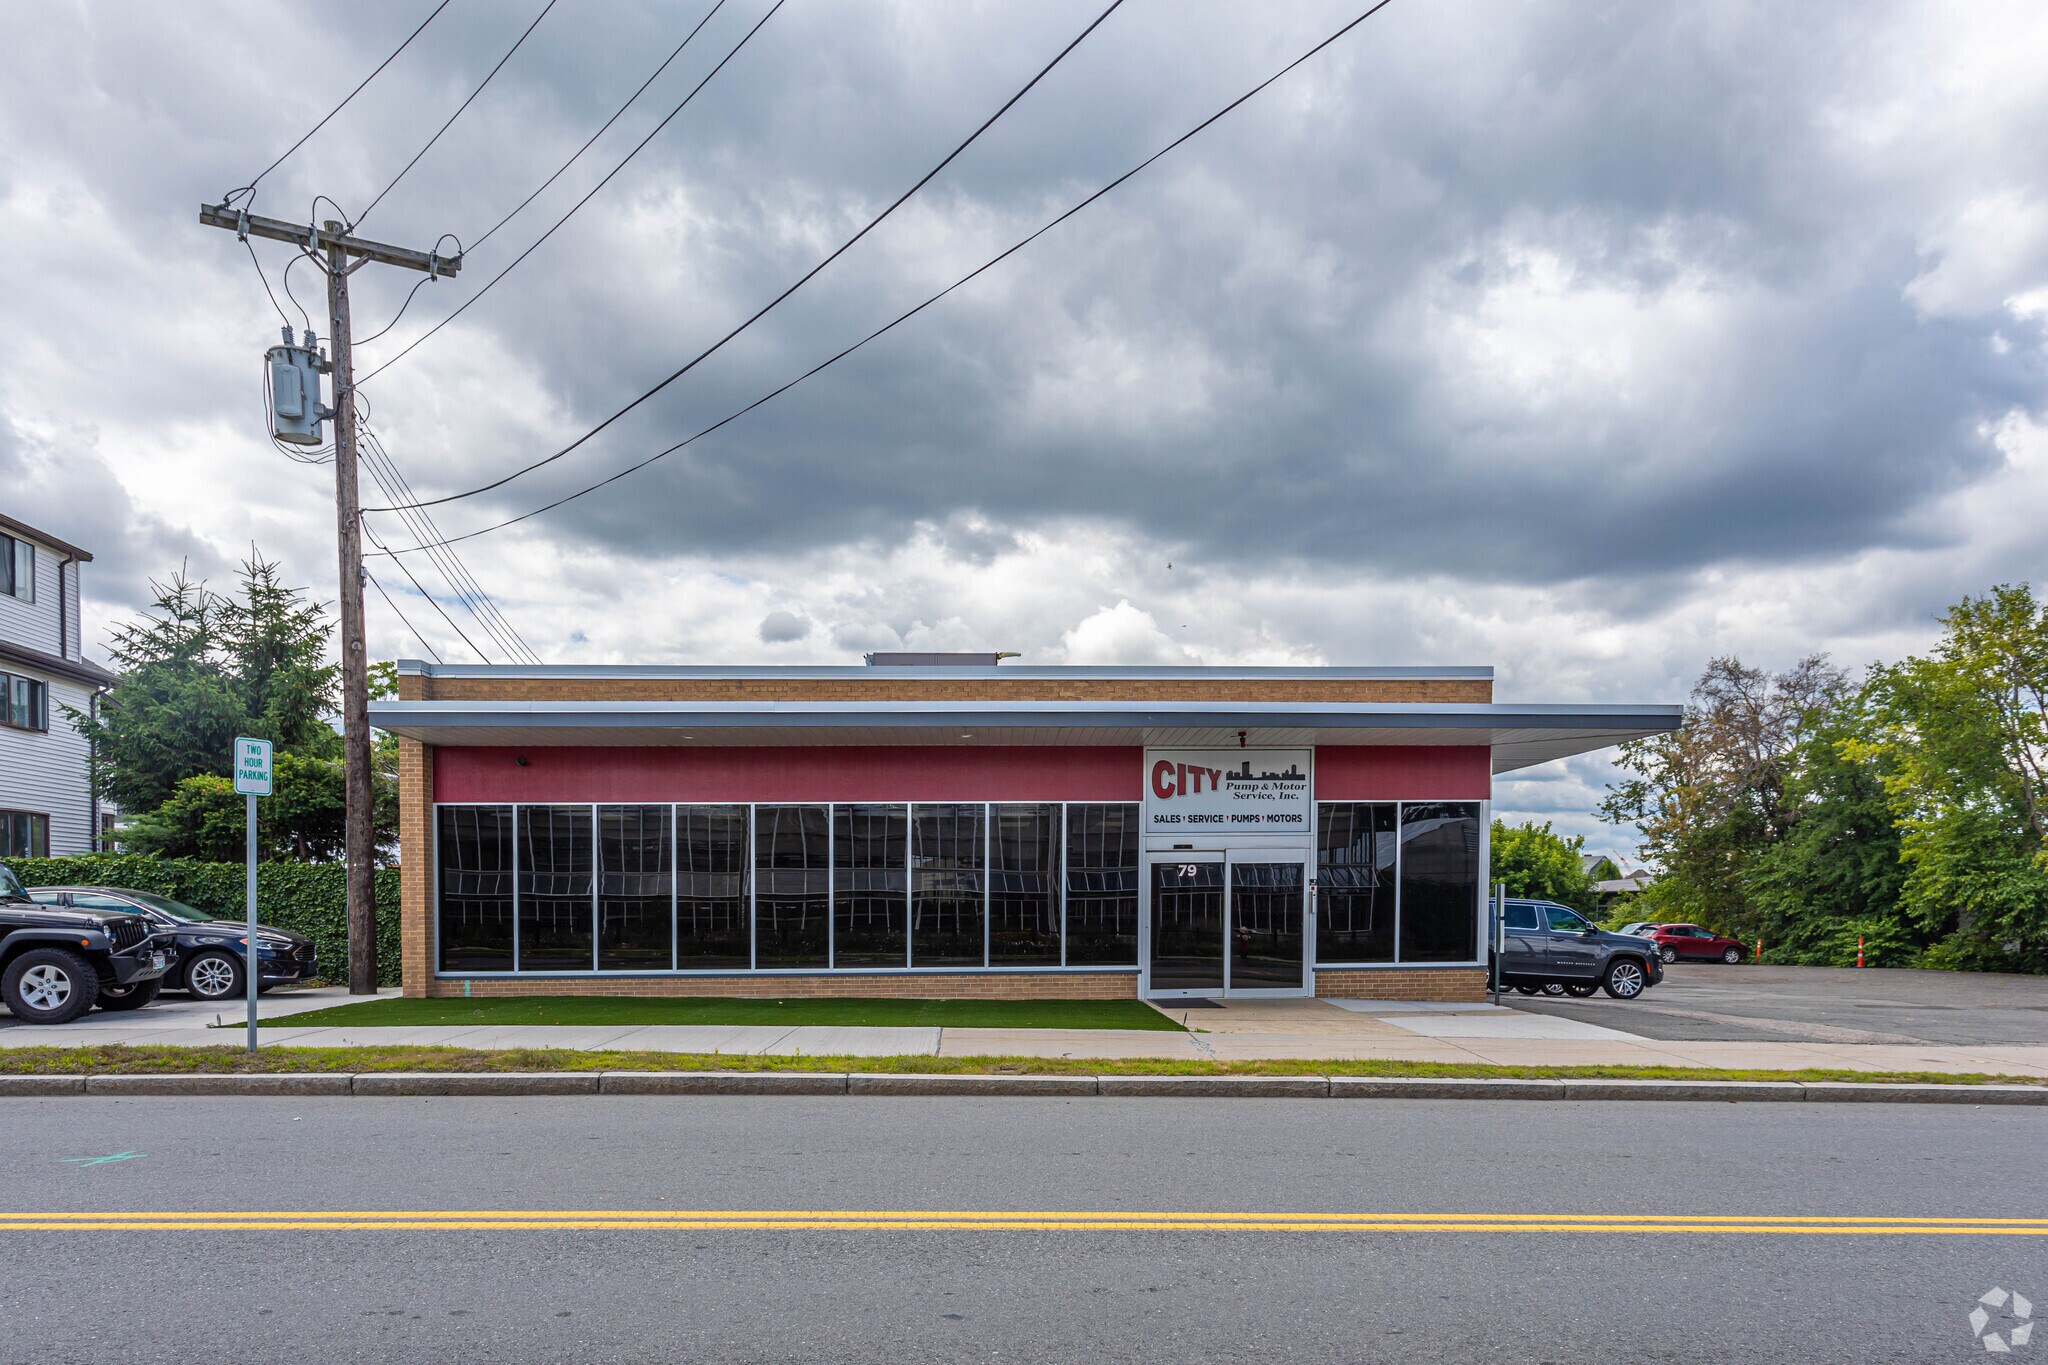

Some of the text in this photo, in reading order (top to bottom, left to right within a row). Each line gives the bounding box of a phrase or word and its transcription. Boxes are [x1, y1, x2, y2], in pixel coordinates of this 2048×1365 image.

[246, 744, 262, 756] TWO
[244, 757, 263, 768] HOUR
[239, 769, 268, 781] PARKING
[1151, 759, 1222, 799] CITY
[1226, 782, 1307, 792] Pump & Motor
[1233, 791, 1299, 801] Service, Inc.
[1153, 814, 1303, 824] SALES SERVICE PUMPS MOTORS
[1178, 864, 1197, 877] 79
